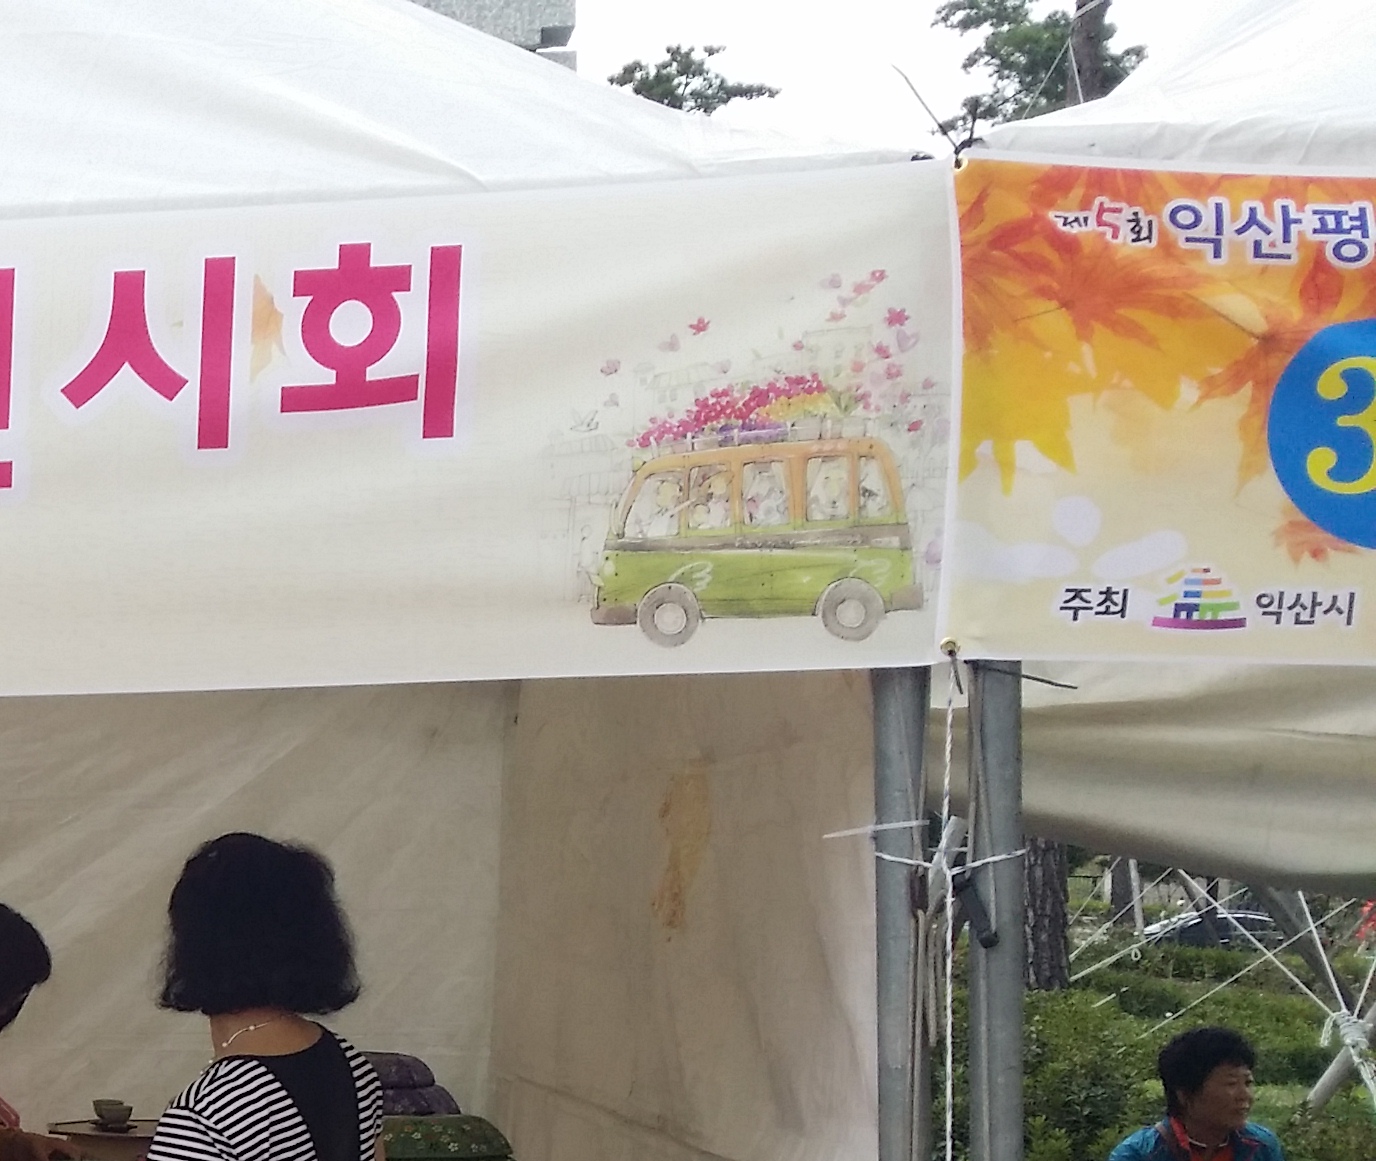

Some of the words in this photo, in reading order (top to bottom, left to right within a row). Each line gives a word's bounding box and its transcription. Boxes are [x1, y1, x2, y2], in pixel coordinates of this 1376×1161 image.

[1168, 201, 1372, 264] 익산평
[1059, 586, 1129, 622] 주최
[1255, 590, 1356, 626] 익산시
